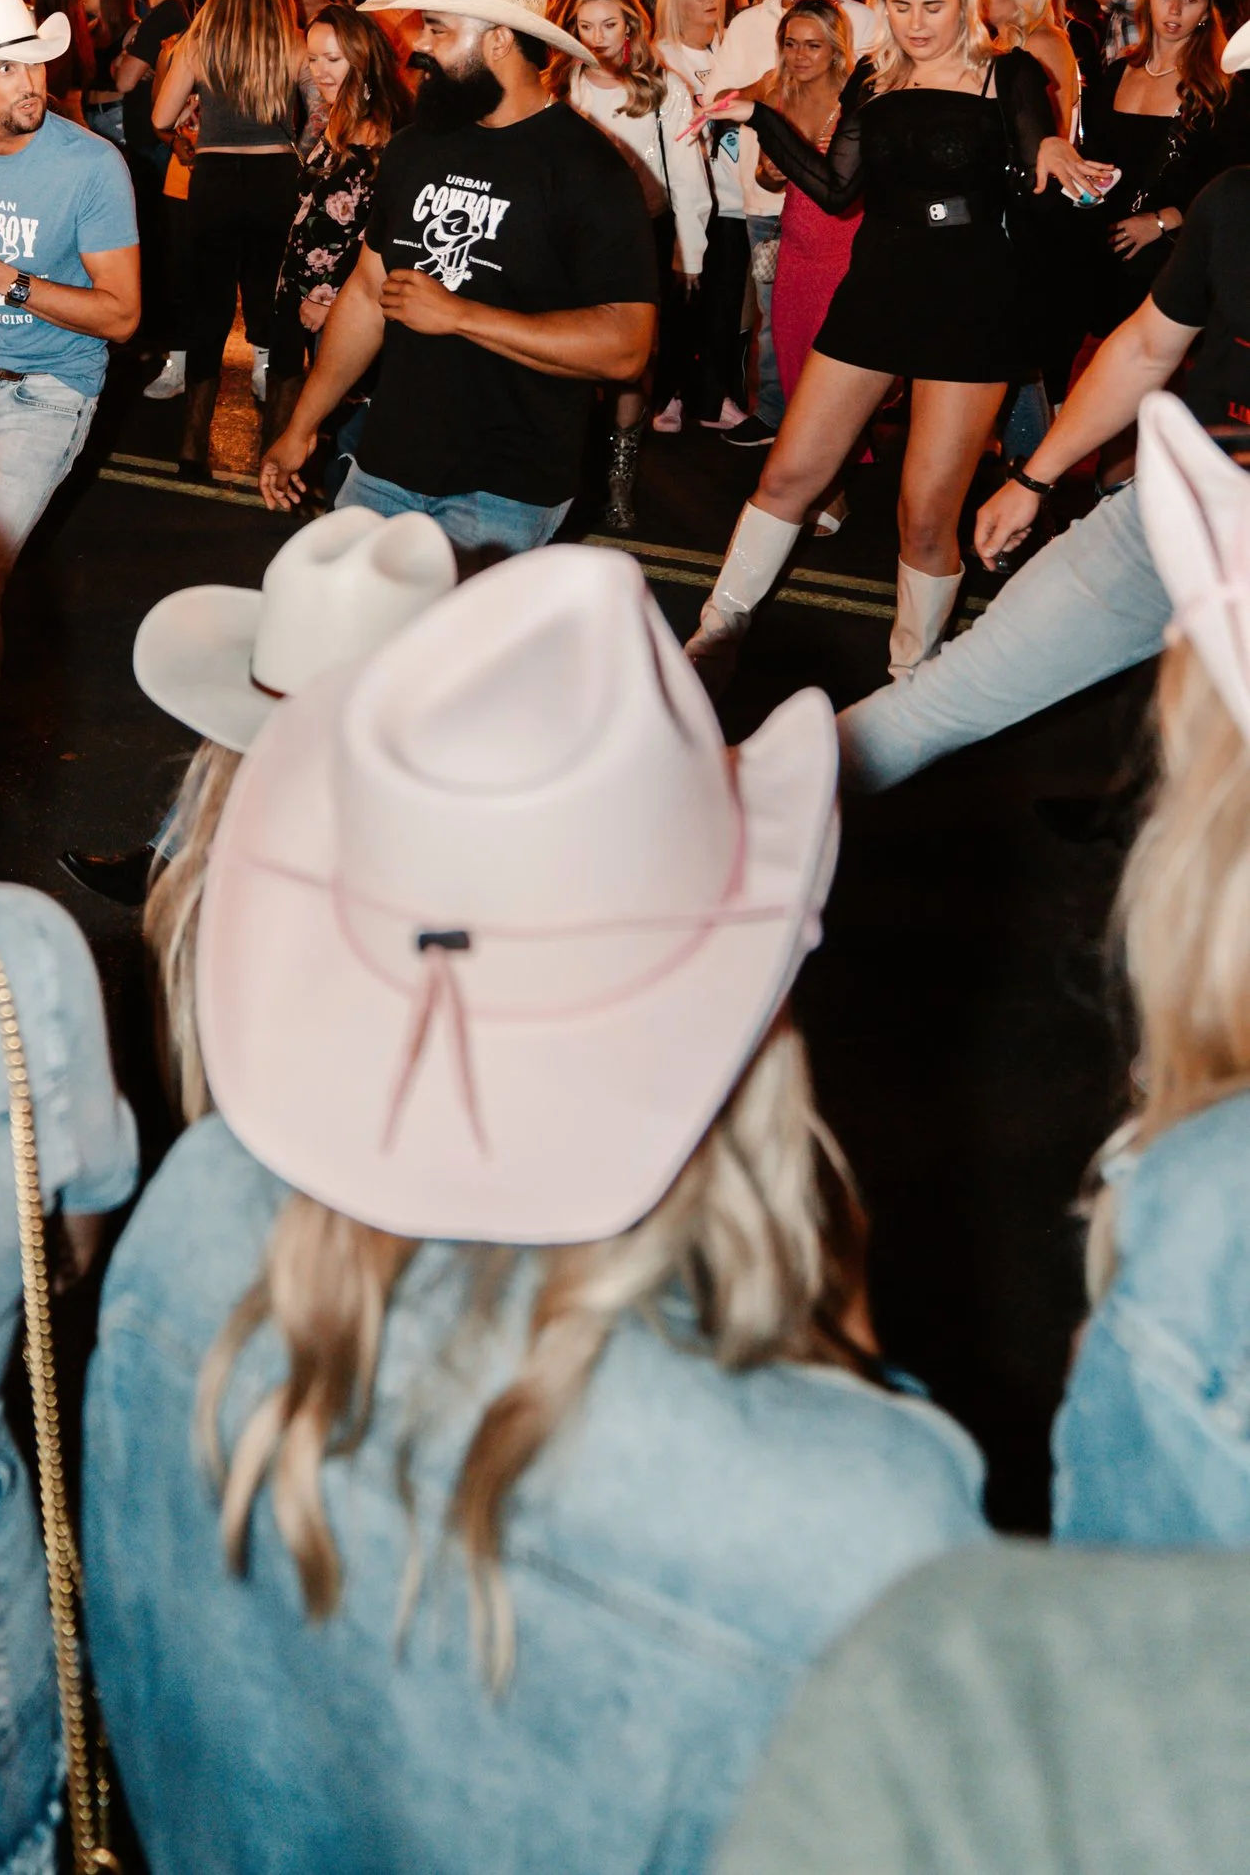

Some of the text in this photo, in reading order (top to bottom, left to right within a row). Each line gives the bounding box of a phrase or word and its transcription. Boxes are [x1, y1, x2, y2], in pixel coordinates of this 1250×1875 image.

[445, 173, 493, 193] URBAN
[411, 182, 512, 241] COWBOY
[392, 237, 423, 250] NASHVILLE
